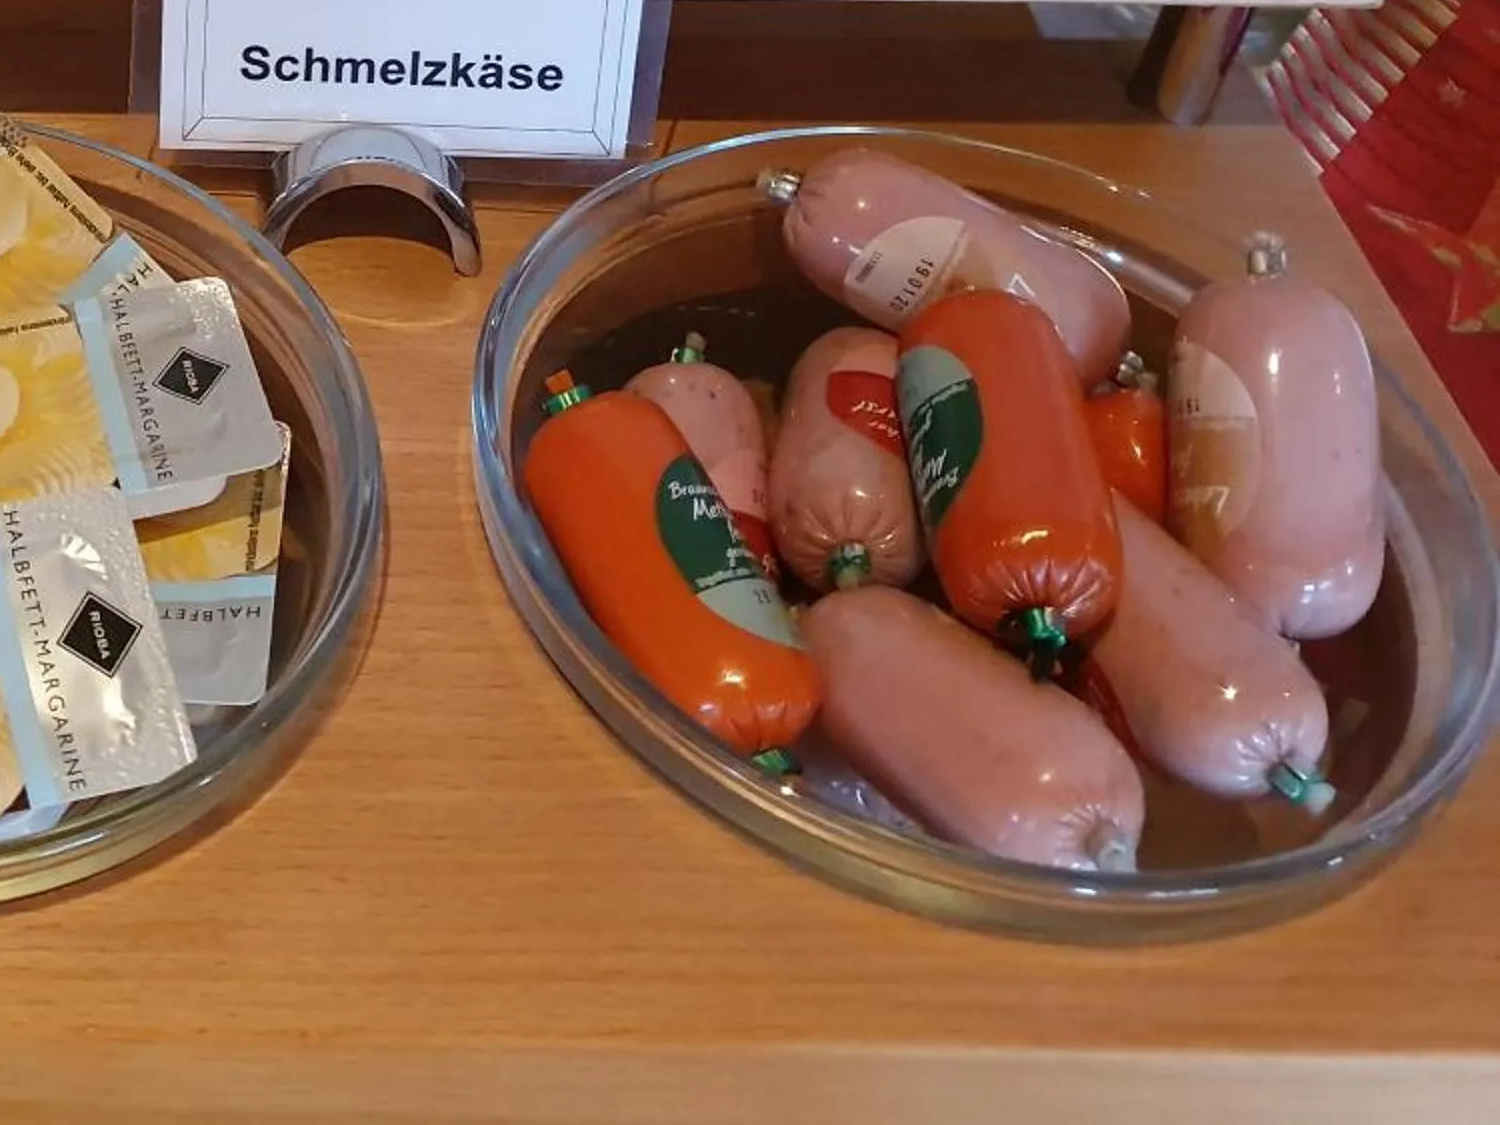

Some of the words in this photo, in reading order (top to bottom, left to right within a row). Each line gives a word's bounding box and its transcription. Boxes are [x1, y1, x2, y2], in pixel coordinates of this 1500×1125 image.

[240, 44, 564, 91] Schmelzkäse
[108, 297, 174, 481] HALBFETT-MARGARINE
[181, 359, 199, 394] RIOBA
[3, 509, 88, 792] HALBFETT-MARGARINE
[88, 610, 111, 660] RIOBA
